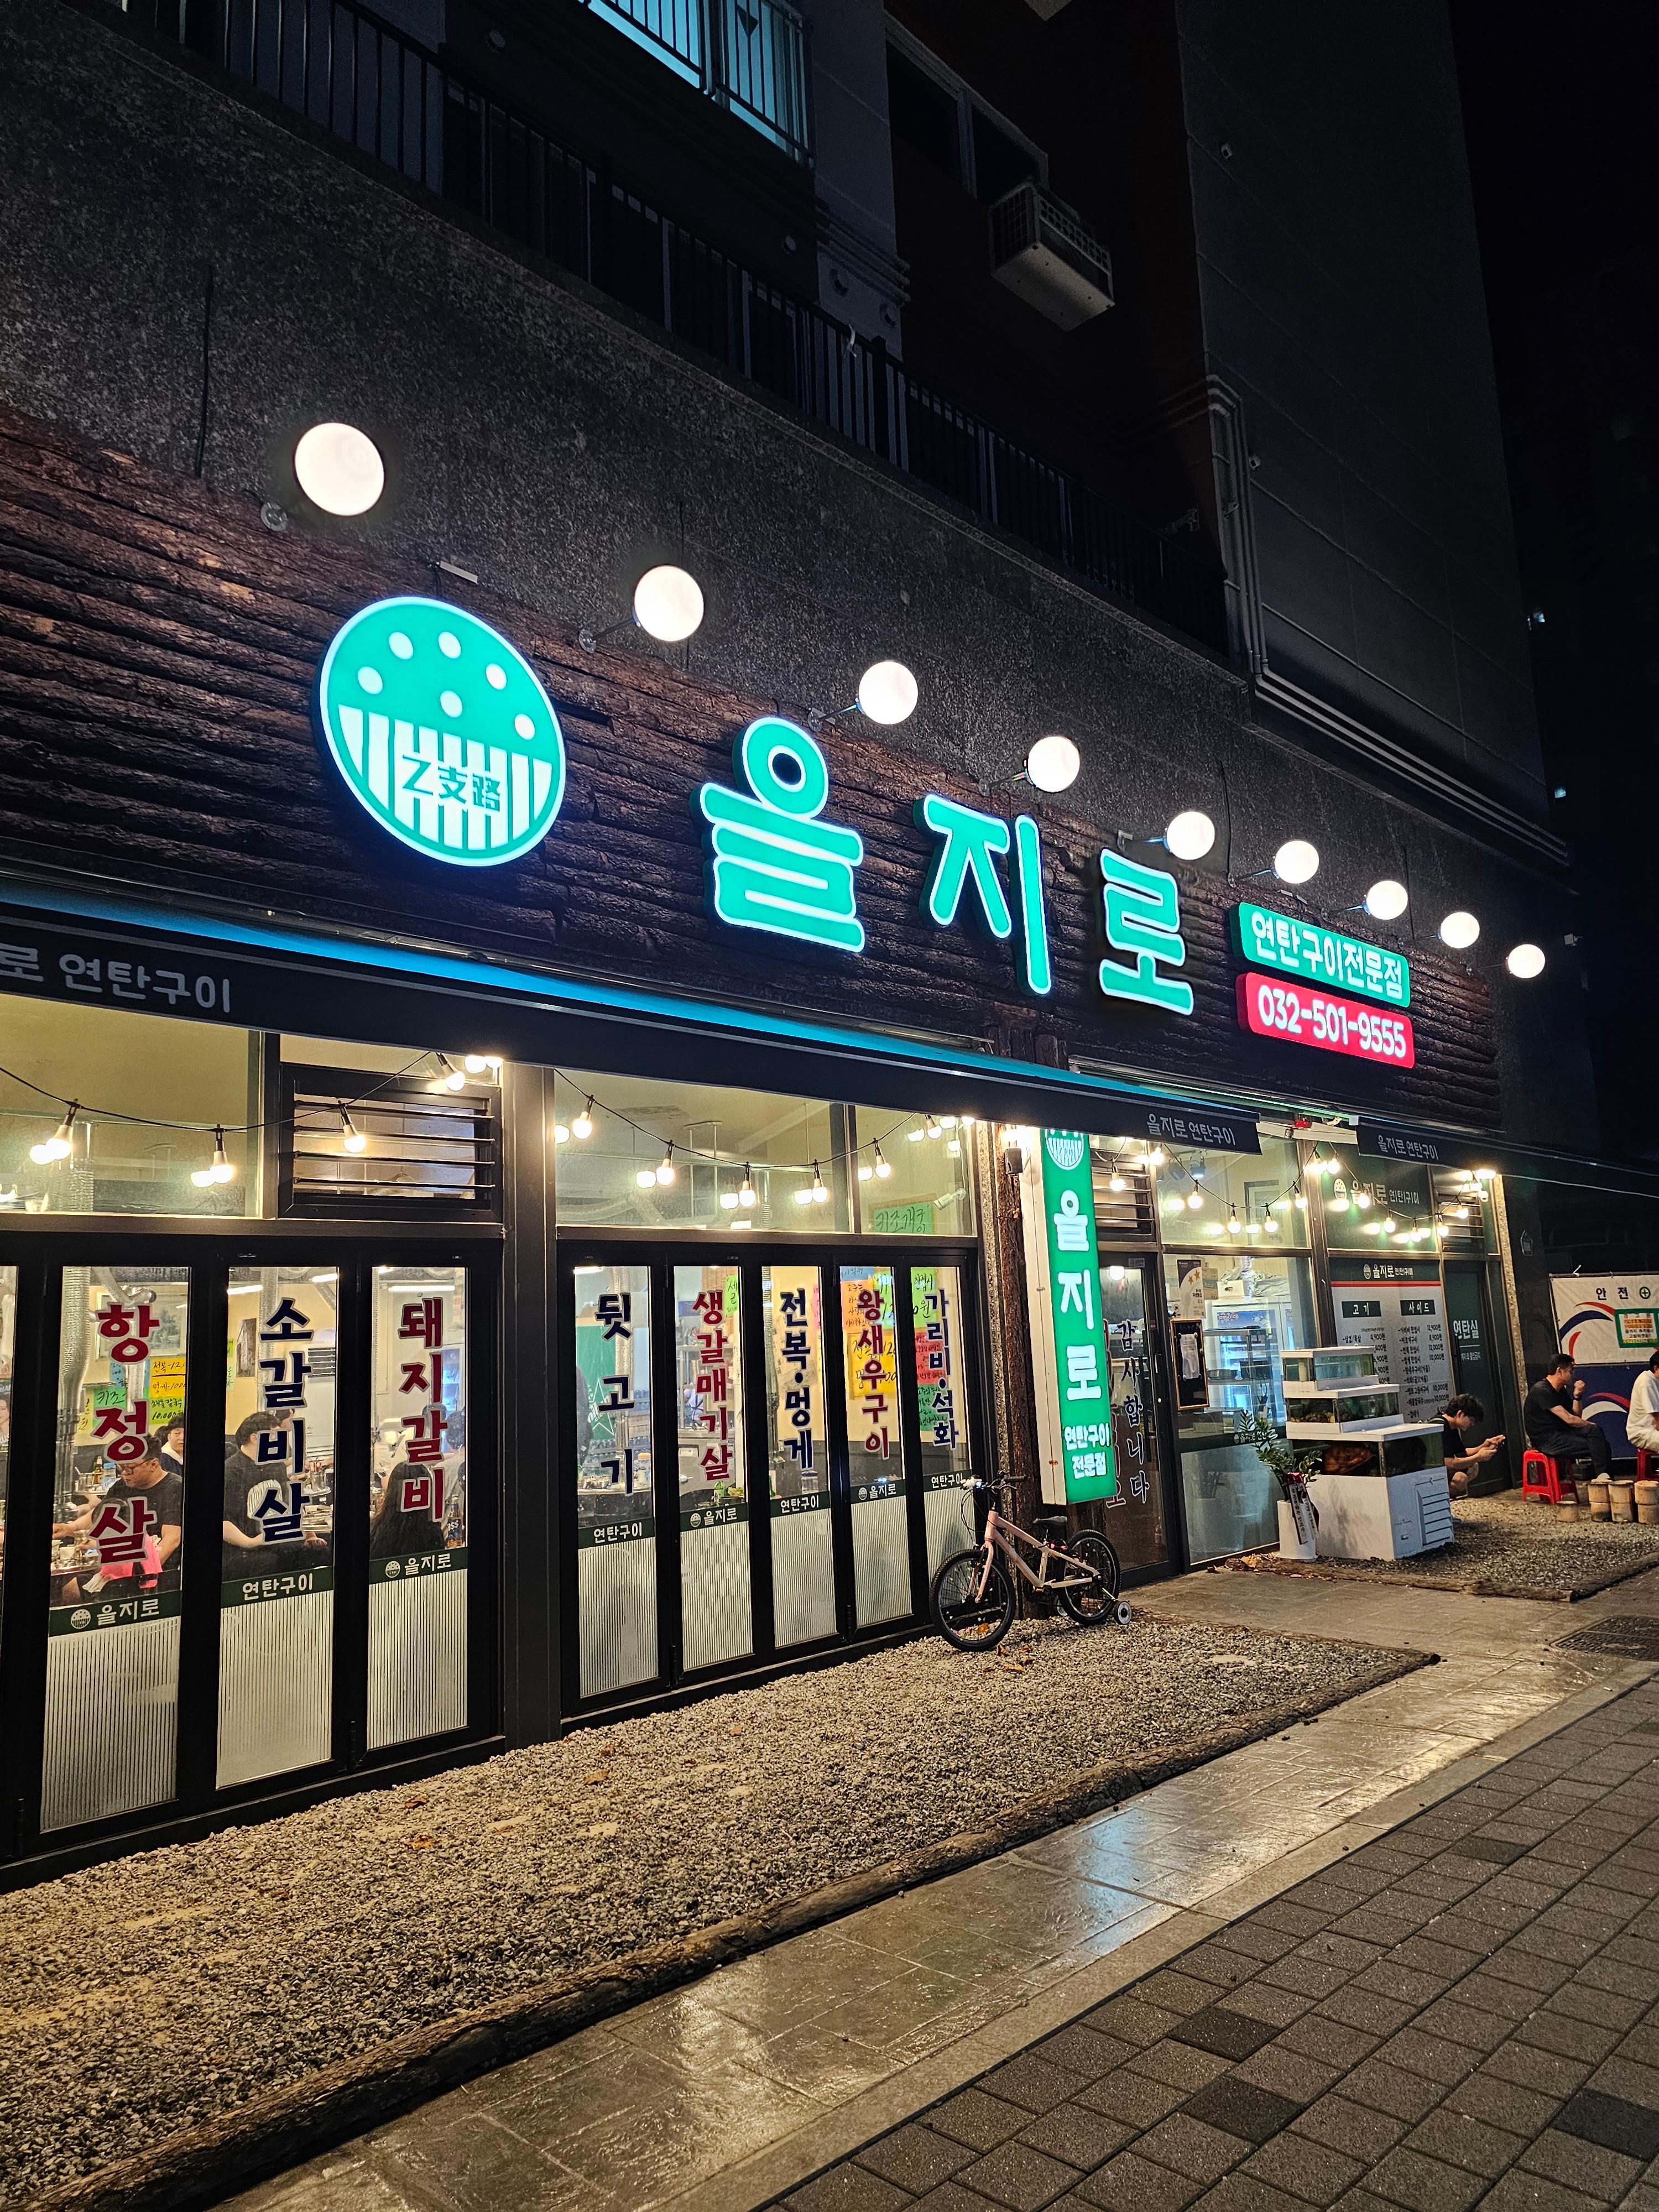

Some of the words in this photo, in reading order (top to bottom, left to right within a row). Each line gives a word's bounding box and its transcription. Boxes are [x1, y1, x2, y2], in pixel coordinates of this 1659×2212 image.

[700, 717, 1195, 1016] 을지로
[1251, 911, 1404, 1000] 연탄구이전문점
[58, 953, 231, 1013] 연탄구이
[1258, 984, 1407, 1058] 032-501-9555
[1147, 1113, 1188, 1138] 을지로
[1188, 1121, 1236, 1146] 연탄구이
[1378, 1134, 1406, 1155] 을지로
[1406, 1140, 1439, 1160] 연탄구이
[1373, 1264, 1395, 1279] 을지로
[1053, 1189, 1103, 1401] 을지로
[1408, 1301, 1430, 1314] 사이드
[1453, 1319, 1479, 1339] 연탄실
[692, 1289, 734, 1482] 생갈매기살
[856, 1288, 890, 1461] 왕새우구이
[594, 1291, 635, 1496] 뒷고기
[252, 1297, 314, 1545] 소갈비살
[397, 1296, 448, 1522] 돼지갈비
[1117, 1318, 1150, 1504] 감사합니다
[88, 1301, 161, 1565] 항정살
[1064, 1422, 1111, 1451] 연탄구이
[931, 1472, 963, 1489] 연탄구이
[1071, 1454, 1108, 1479] 전문점
[780, 1495, 820, 1514] 연탄구이
[869, 1482, 897, 1500] 을지로
[703, 1507, 738, 1527] 을지로
[593, 1521, 643, 1544] 연탄구이
[404, 1553, 451, 1575] 을지로
[241, 1573, 314, 1602] 연탄구이
[96, 1598, 160, 1627] 을지로
